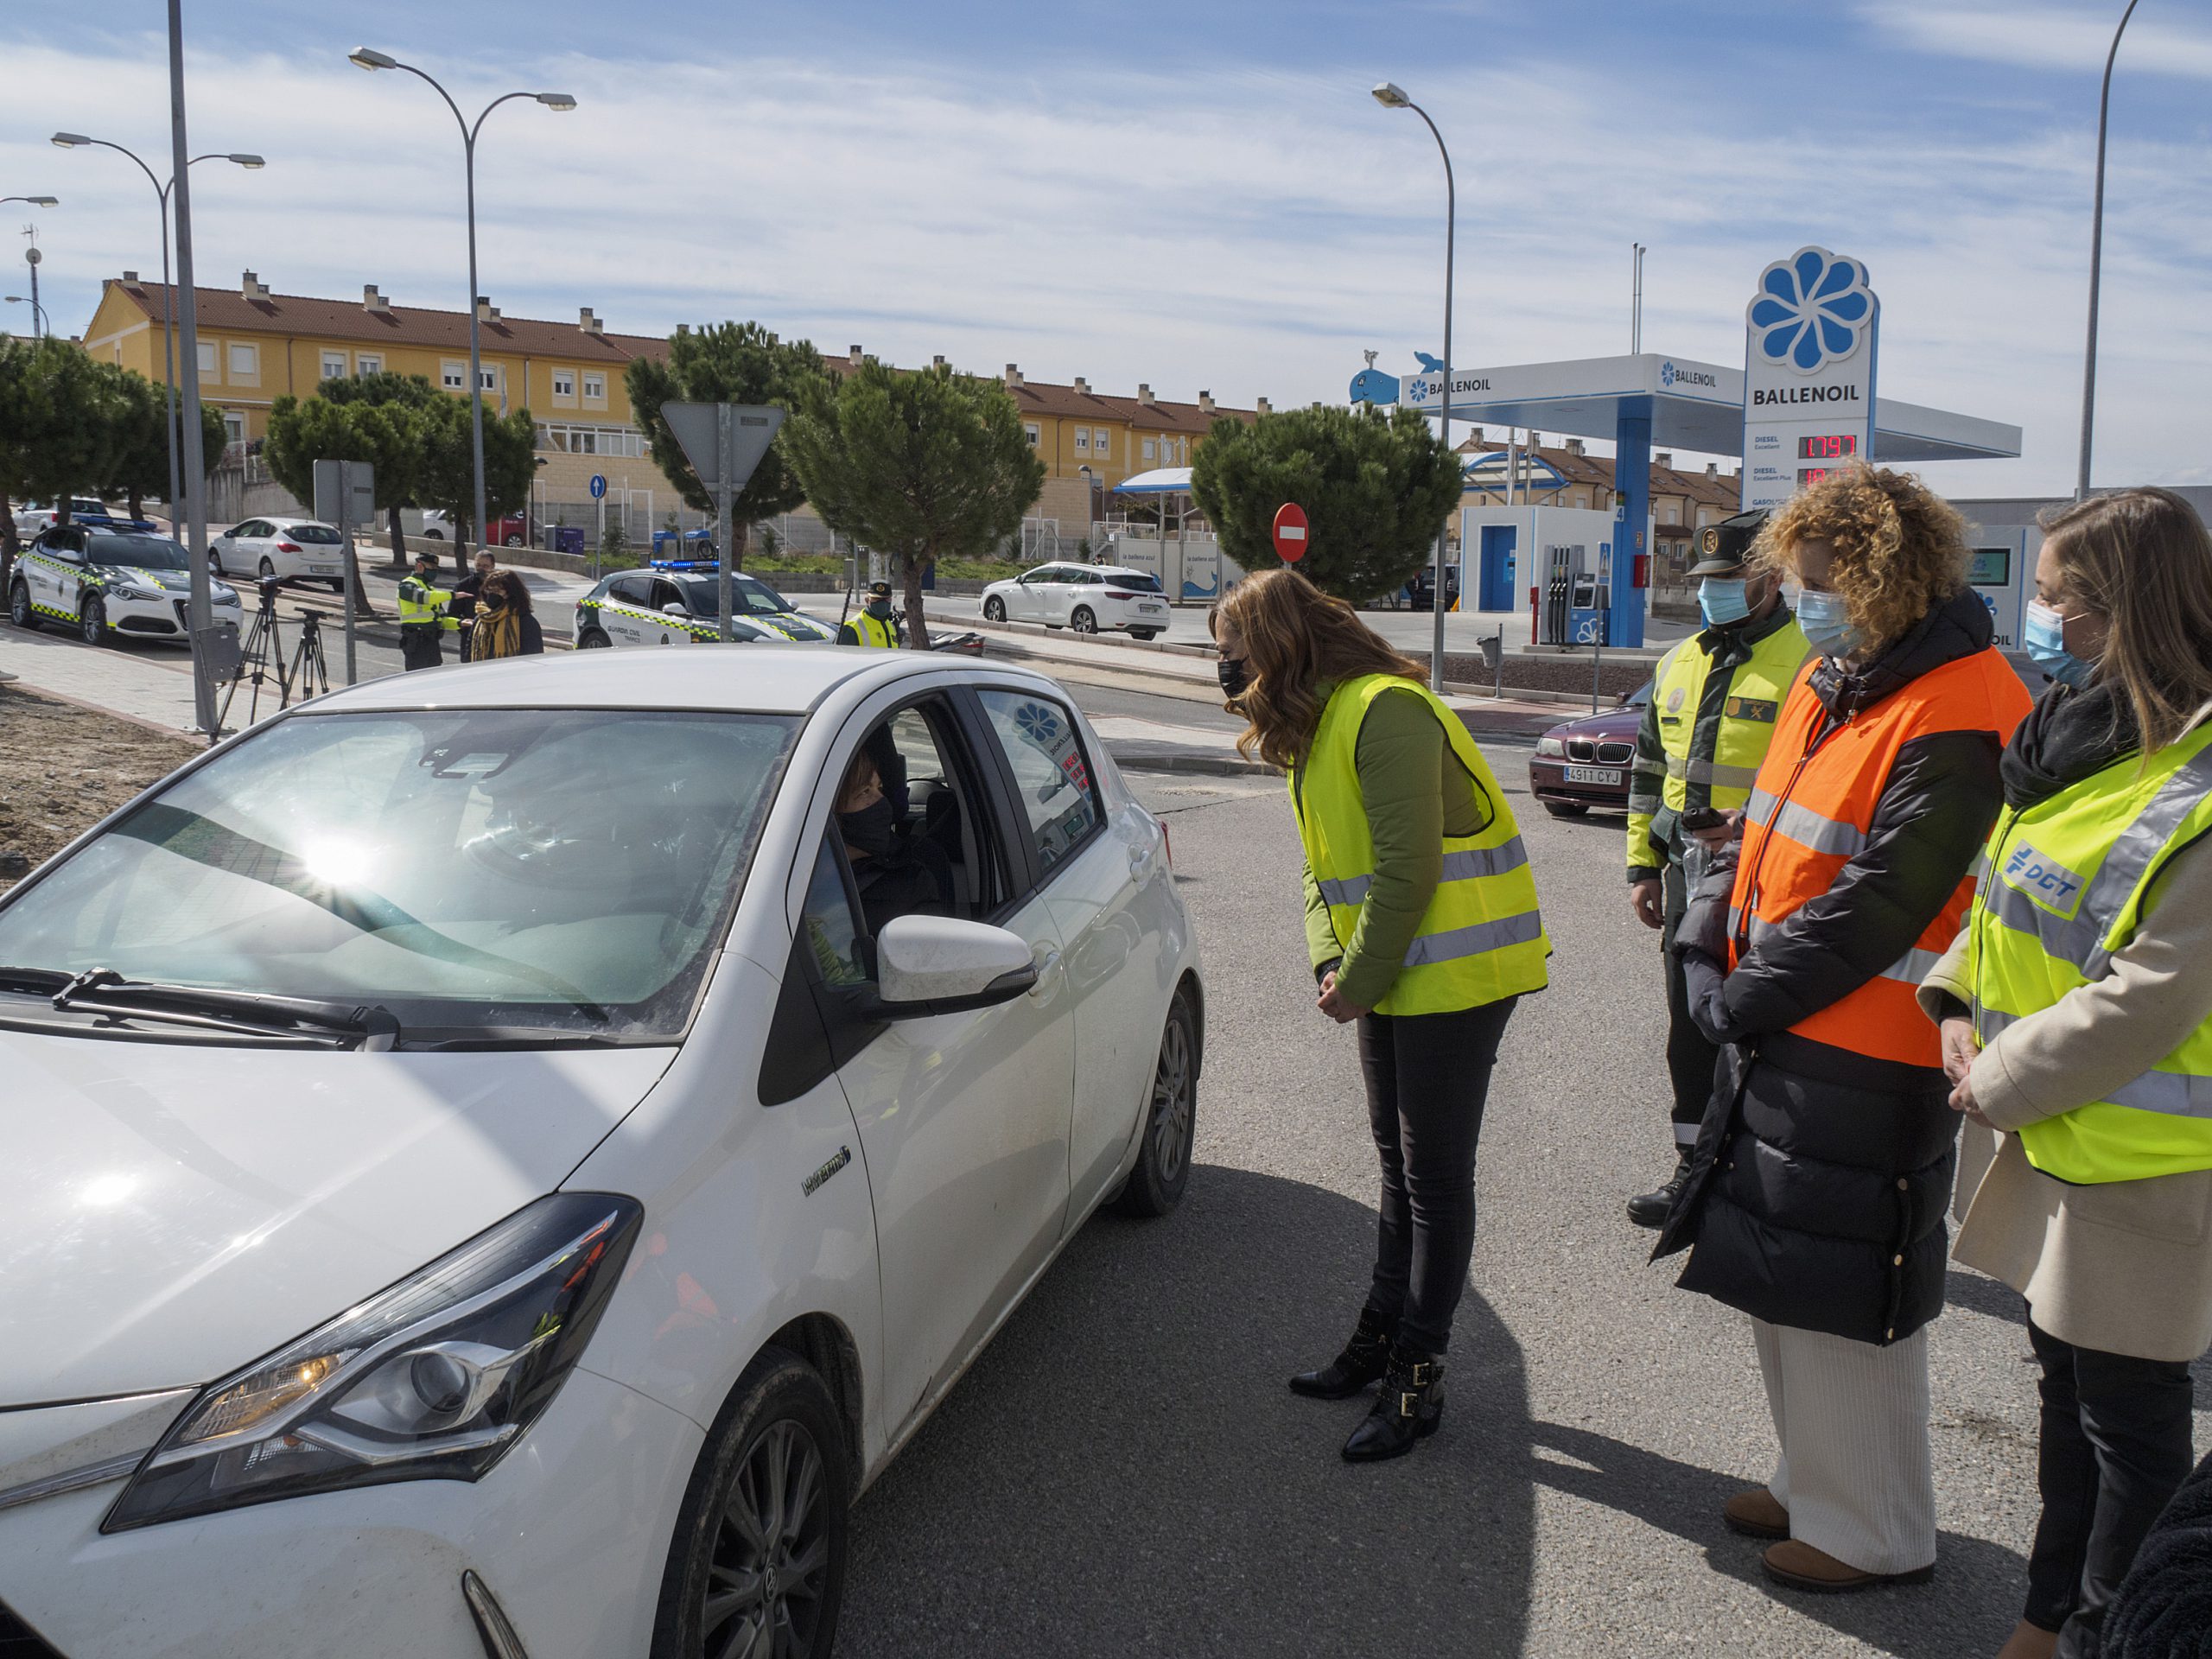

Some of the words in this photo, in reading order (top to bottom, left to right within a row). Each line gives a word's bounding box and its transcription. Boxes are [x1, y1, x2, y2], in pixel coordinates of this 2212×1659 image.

[1430, 378, 1491, 395] BALENOIL
[1675, 370, 1716, 387] BALLENOIL
[1753, 385, 1859, 405] BALLENOIL
[1617, 507, 1624, 520] 4
[1570, 769, 1593, 781] 4911
[1597, 771, 1619, 784] CYJ
[2024, 863, 2077, 897] DGT
